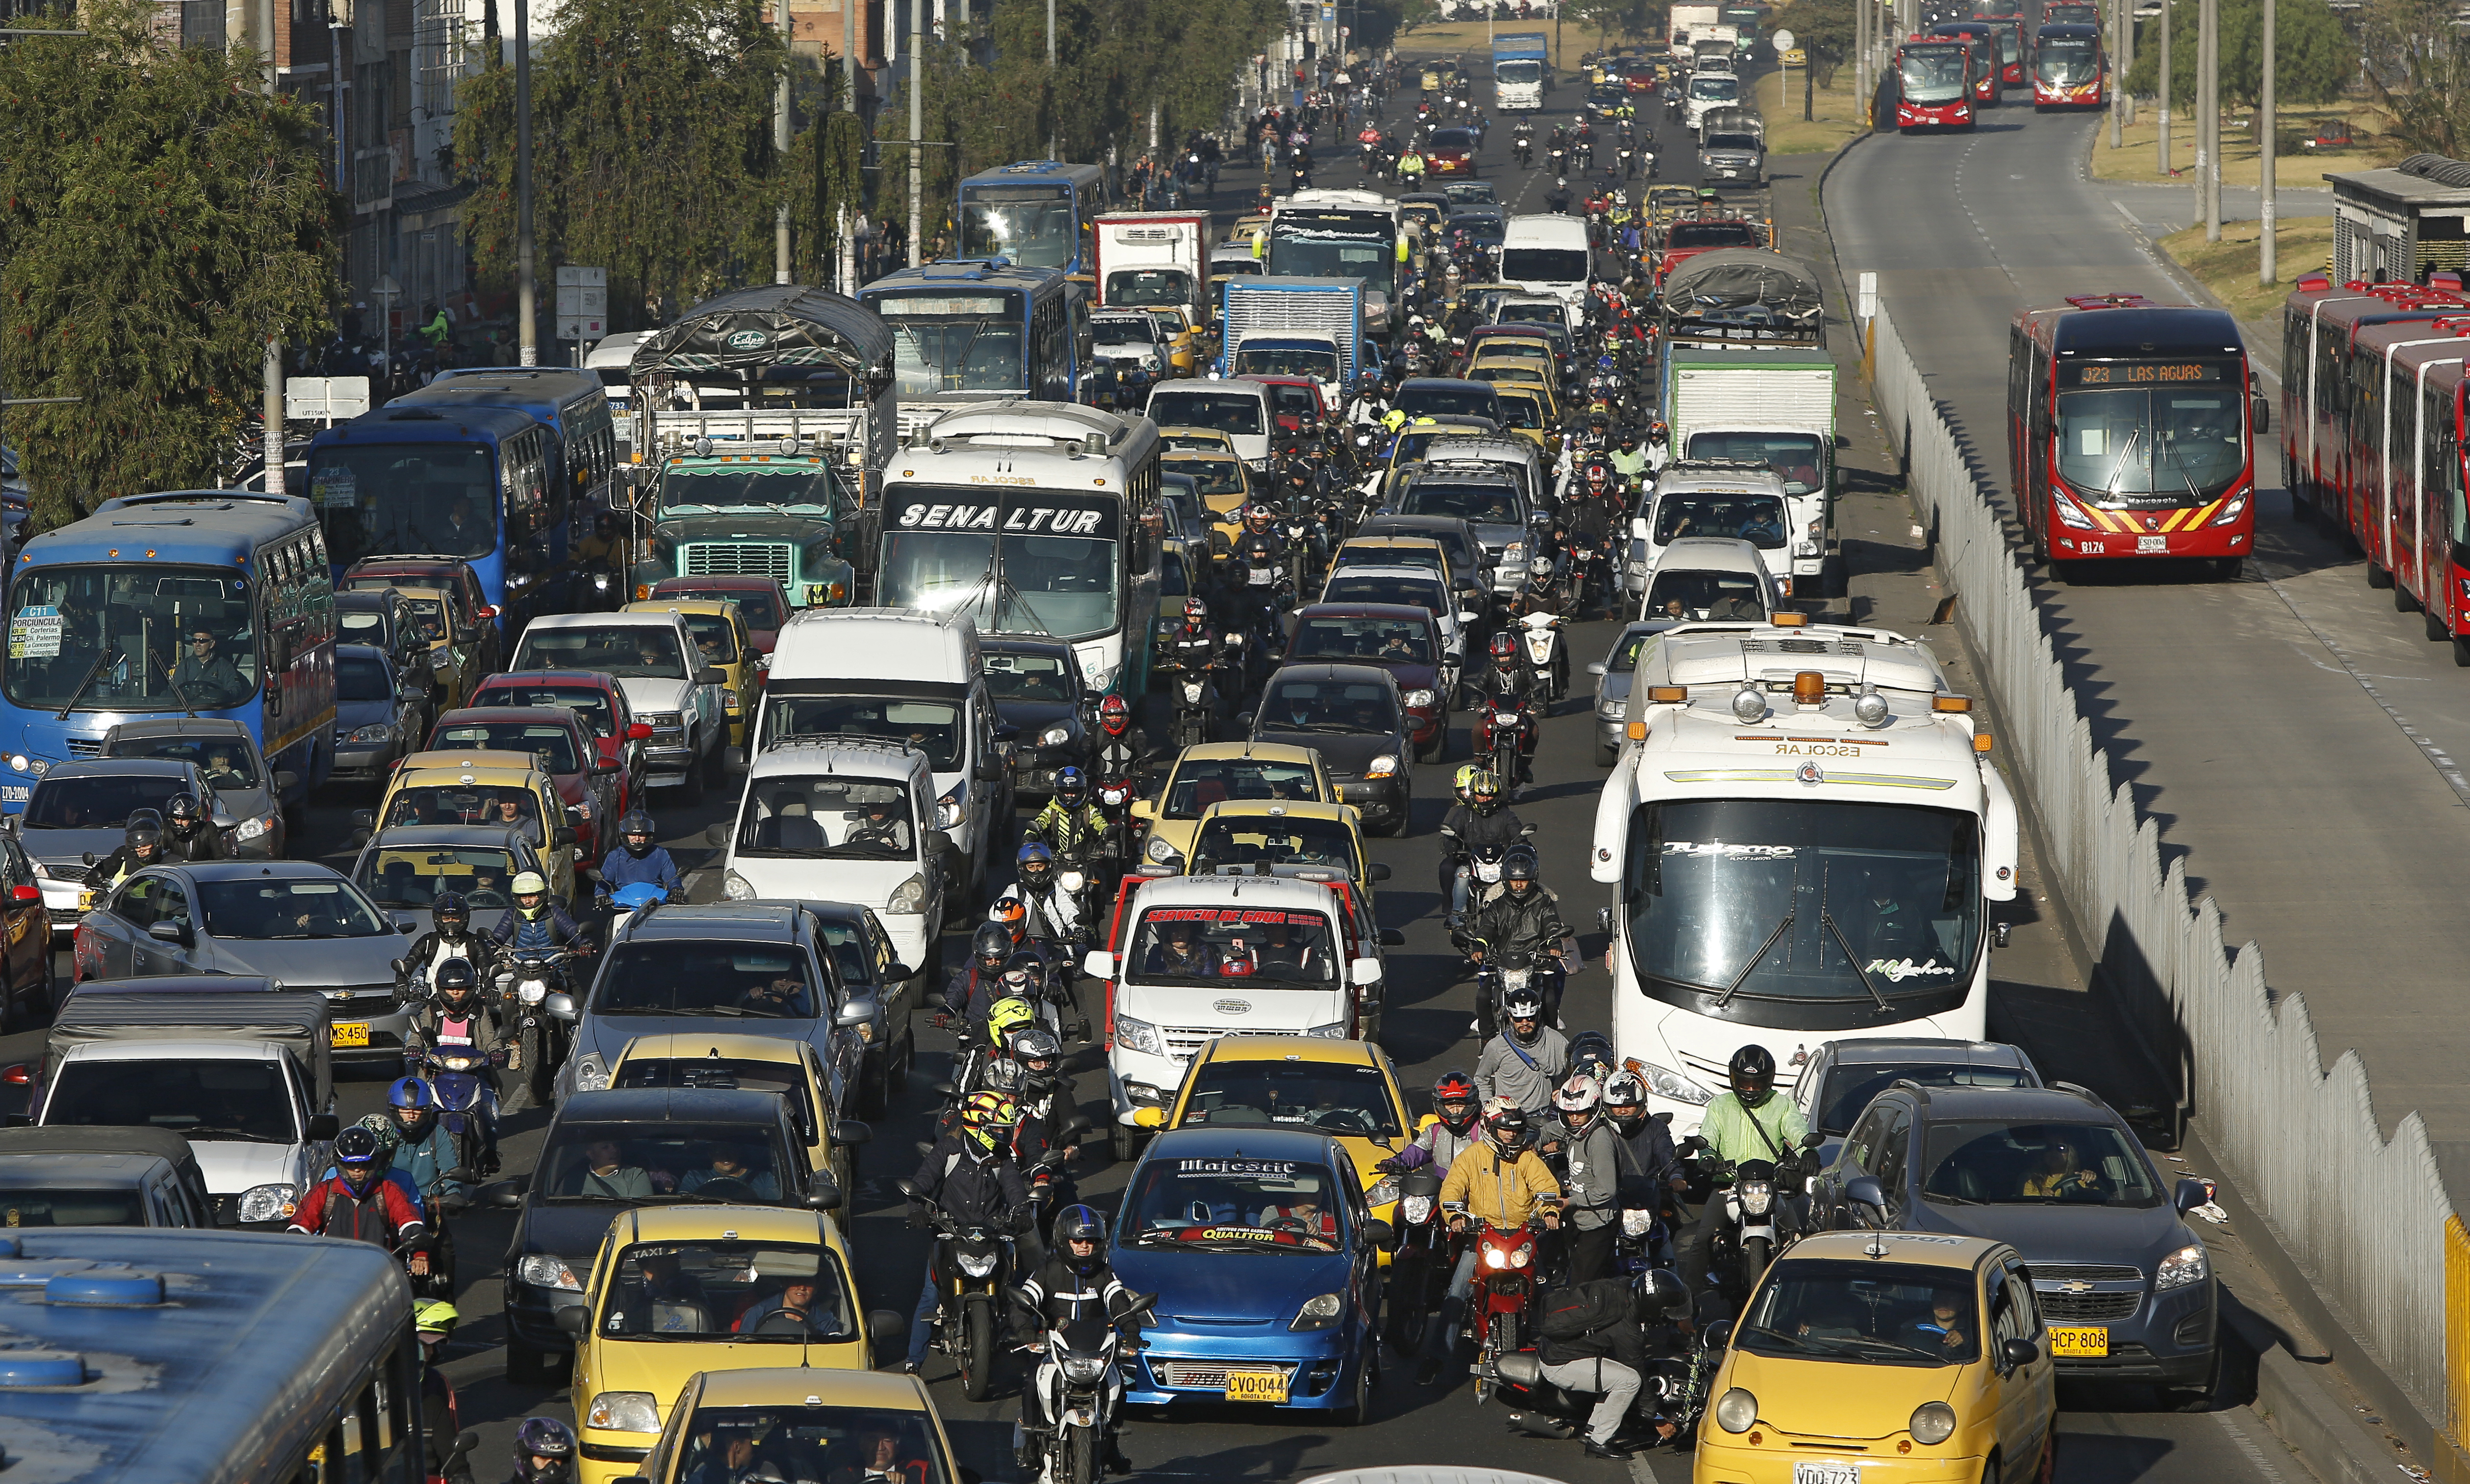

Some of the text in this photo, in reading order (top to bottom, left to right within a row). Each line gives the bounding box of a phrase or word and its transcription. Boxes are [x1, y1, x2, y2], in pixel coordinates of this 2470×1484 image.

[734, 333, 764, 346] Eclipse
[2083, 365, 2203, 382] J23 LAS AGUAS
[313, 475, 355, 485] CHAPINERO
[899, 504, 1102, 533] SENA LTUR
[29, 607, 47, 616] C11
[13, 617, 61, 626] PORCIÚNCULA
[1, 786, 29, 799] Z70-2004
[1144, 910, 1217, 922] SERVICIO
[1218, 911, 1240, 922] DE
[1241, 912, 1286, 924] GRUA
[1202, 1229, 1275, 1241] QUALITOR
[633, 1247, 663, 1258] TAXI
